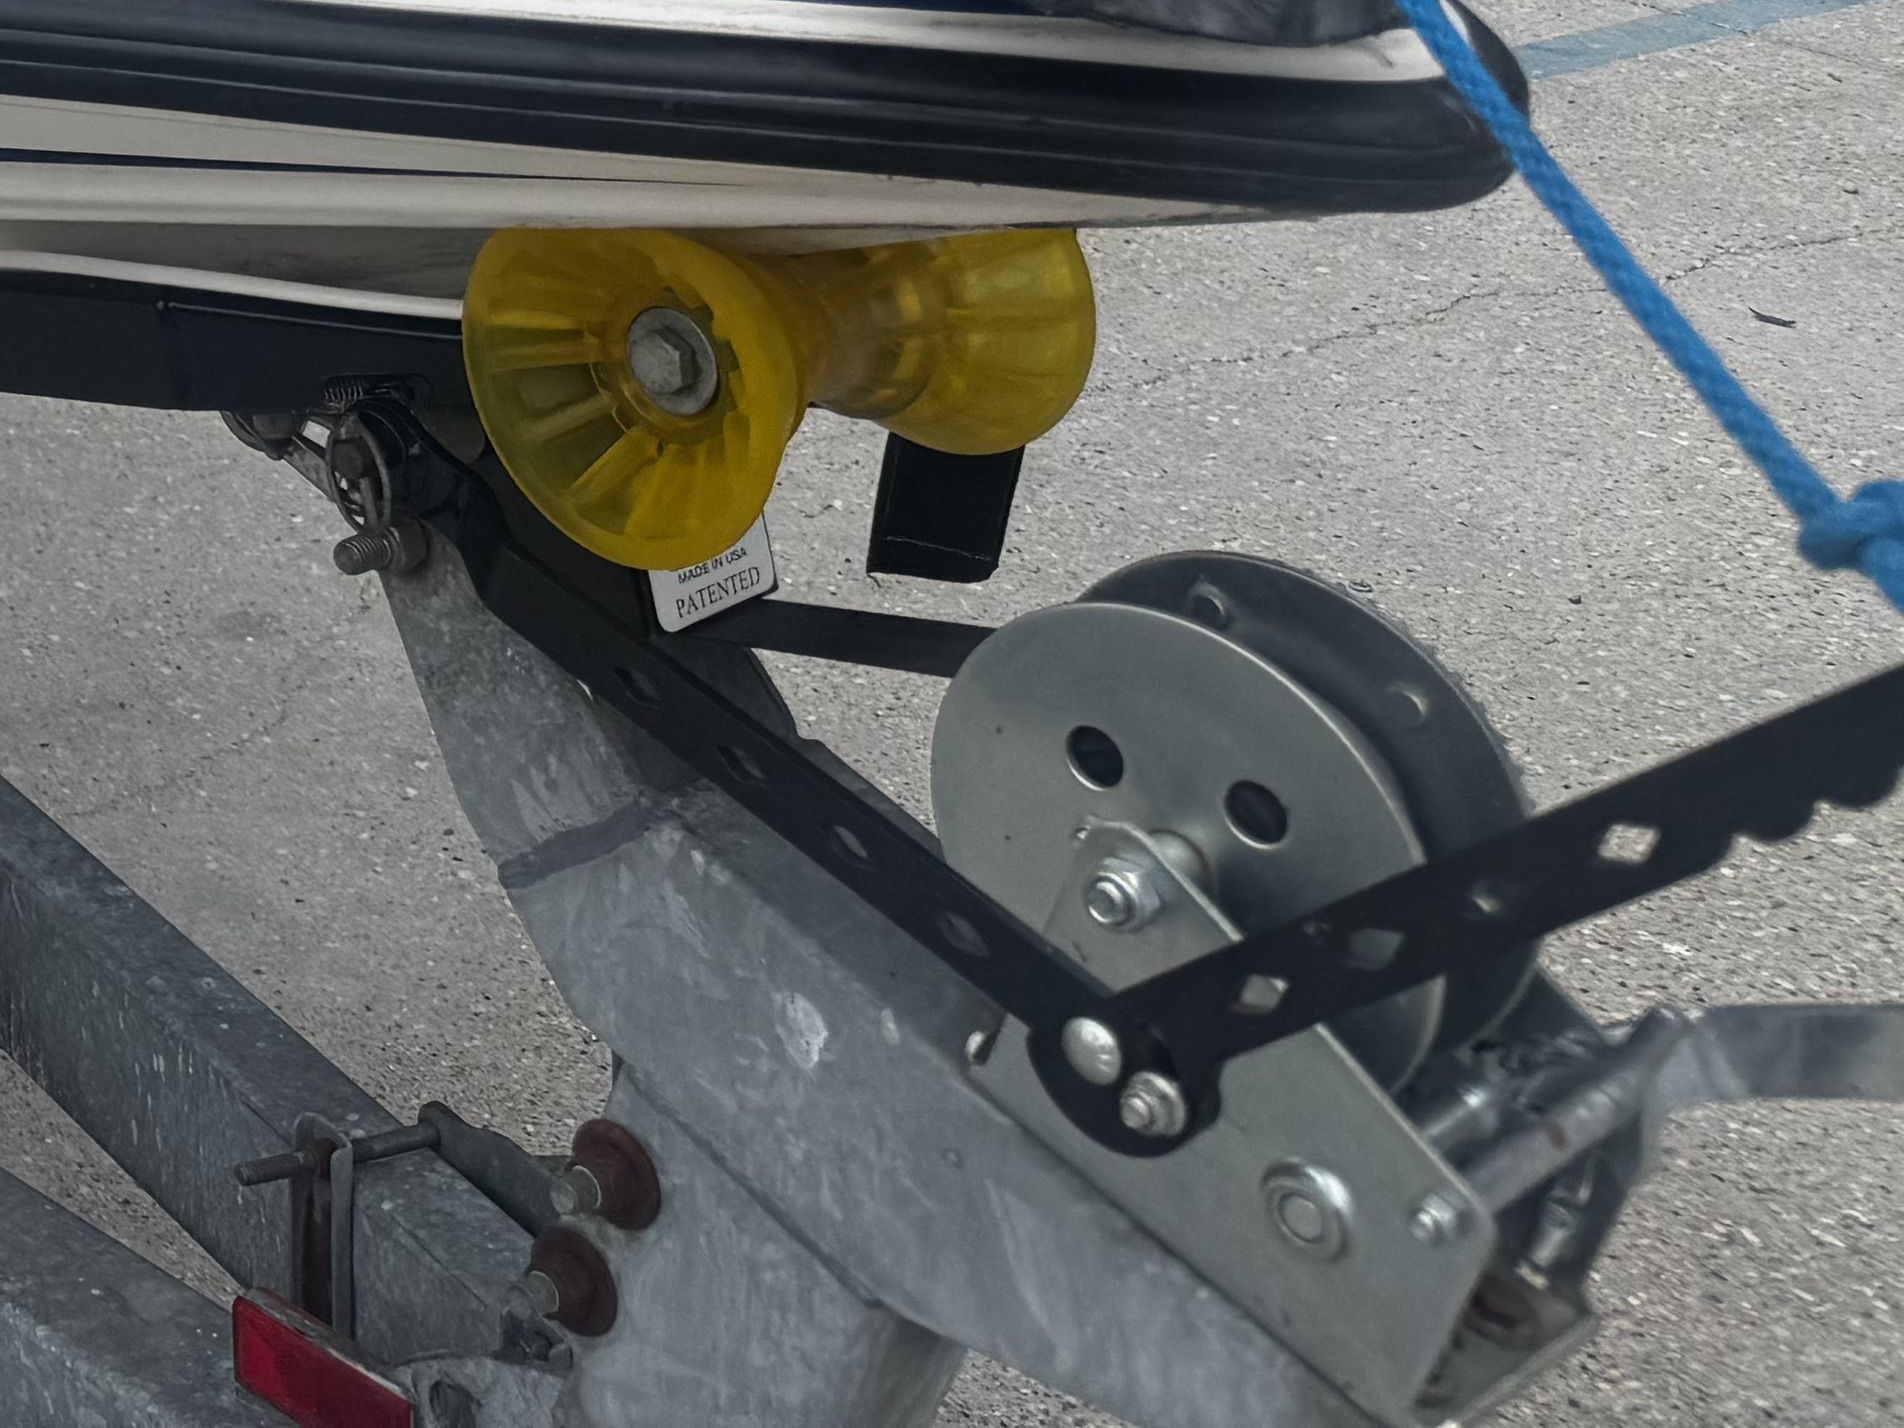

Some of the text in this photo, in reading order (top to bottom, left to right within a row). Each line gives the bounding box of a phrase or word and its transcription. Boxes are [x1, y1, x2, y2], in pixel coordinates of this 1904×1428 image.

[678, 547, 747, 584] MADE IN USA
[675, 566, 761, 619] PATENTED
